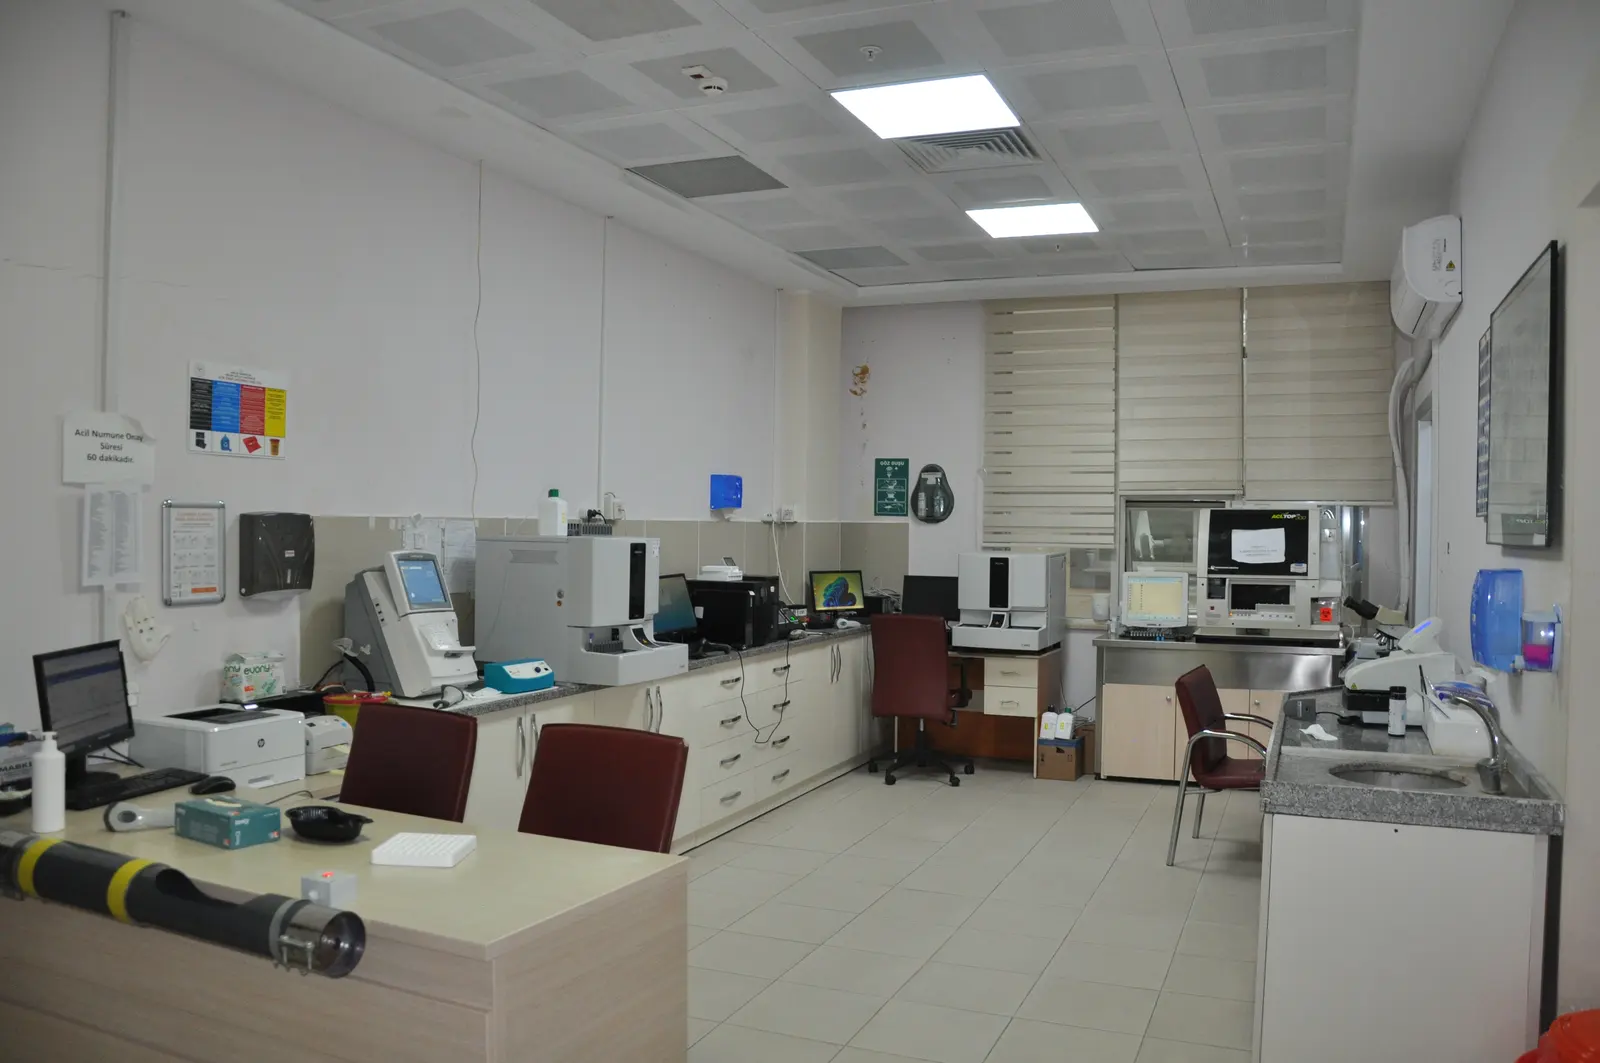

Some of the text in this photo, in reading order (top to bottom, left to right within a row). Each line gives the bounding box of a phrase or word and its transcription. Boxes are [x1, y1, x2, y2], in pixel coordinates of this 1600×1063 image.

[74, 429, 144, 442] Acil Numune Onay
[100, 442, 123, 451] Süresi
[87, 453, 97, 461] 60
[243, 664, 270, 675] evony
